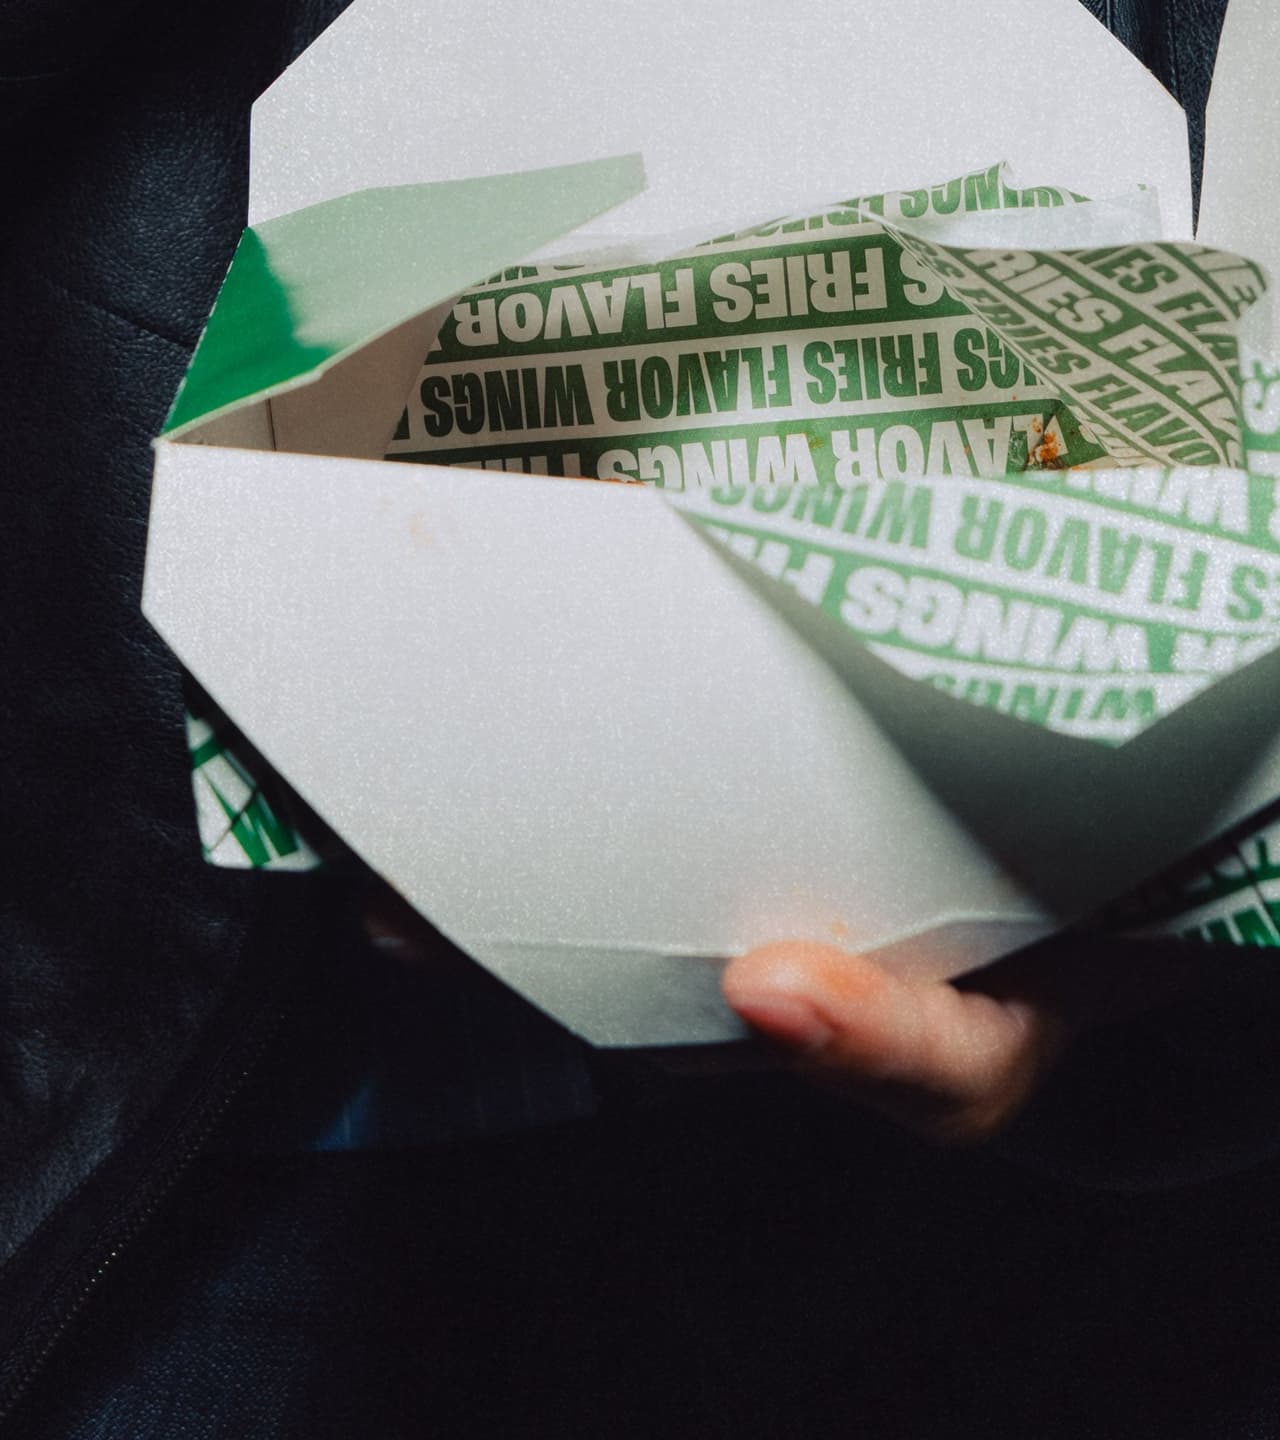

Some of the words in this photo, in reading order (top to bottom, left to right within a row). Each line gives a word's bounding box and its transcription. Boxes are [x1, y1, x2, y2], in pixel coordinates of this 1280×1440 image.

[453, 262, 699, 348] FLAVOR
[709, 246, 888, 323] FRIES
[1080, 242, 1178, 294] IES
[604, 343, 792, 421] FLAVOR
[802, 331, 943, 404] FRIES
[970, 250, 1124, 334] RIES
[1097, 322, 1242, 445] FLAV
[420, 363, 595, 439] WINGS
[1071, 374, 1221, 466] FLAVO
[954, 494, 1208, 613] FLAVOR
[839, 565, 1152, 673] WINGS
